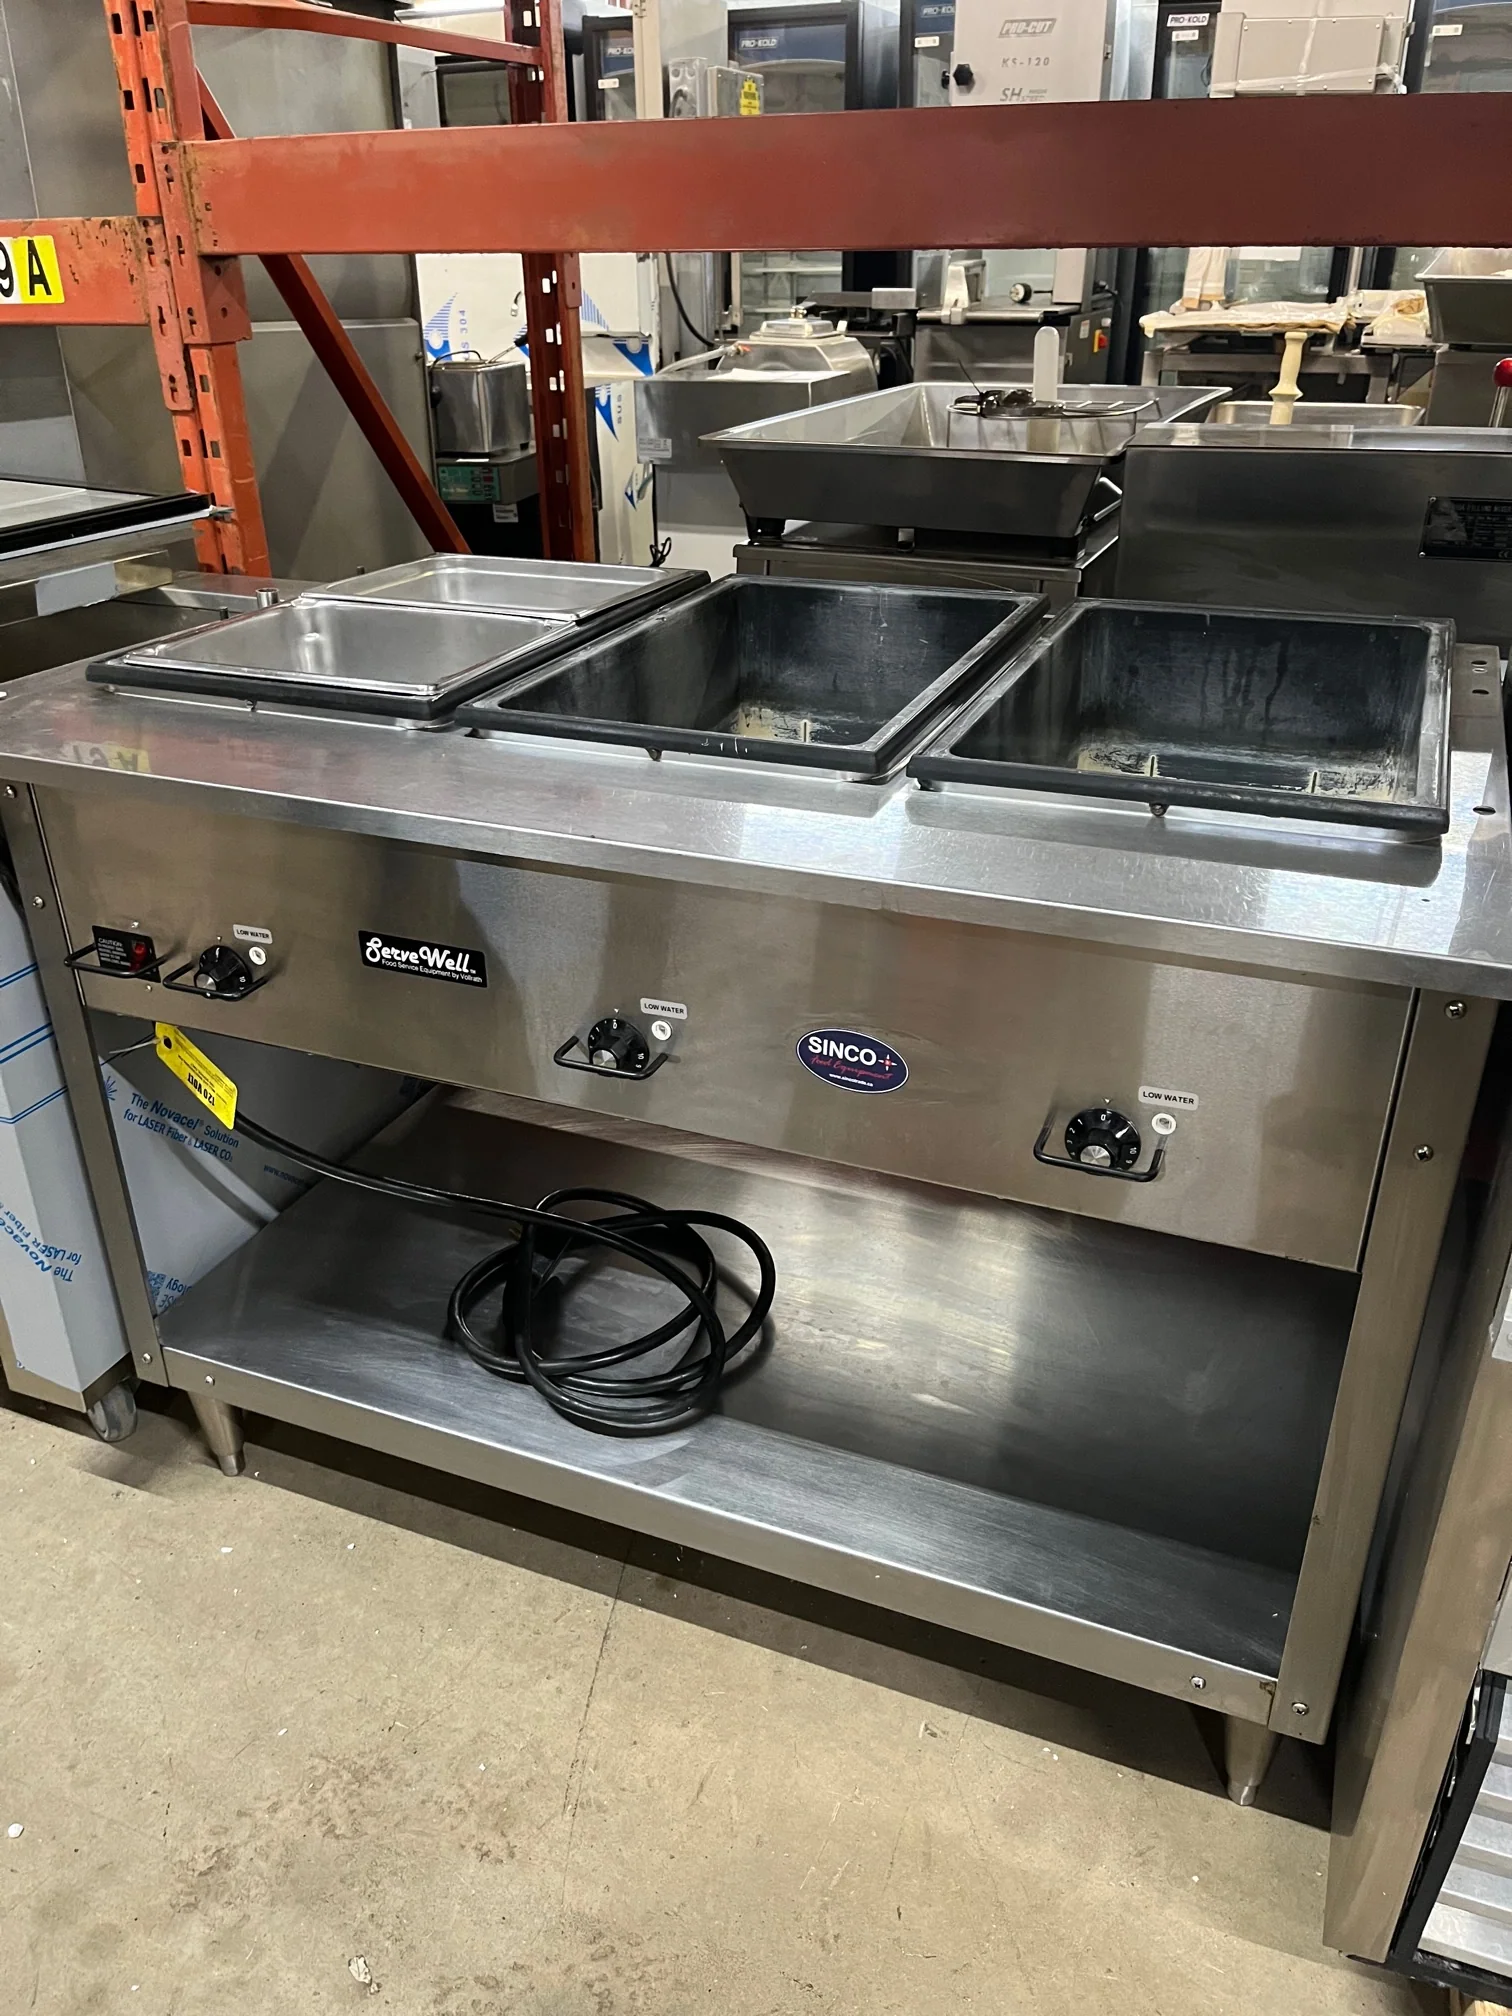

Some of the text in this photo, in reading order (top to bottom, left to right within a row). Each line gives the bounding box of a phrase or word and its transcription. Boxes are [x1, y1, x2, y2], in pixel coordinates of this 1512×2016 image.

[1002, 21, 1053, 34] PRO-CUT
[250, 931, 269, 939] WATER
[382, 959, 397, 968] Food
[398, 962, 419, 972] Service
[419, 966, 451, 977] Equipment
[451, 971, 460, 980] by
[660, 1005, 684, 1014] WATER
[808, 1036, 877, 1066] SINCO
[1142, 1091, 1195, 1104] LOW WATER
[131, 1093, 149, 1110] The
[203, 1125, 239, 1148] Solution
[123, 1108, 138, 1122] for
[138, 1115, 165, 1134] LASER
[166, 1126, 188, 1143] Fiber
[194, 1138, 220, 1157] LASER
[4, 1210, 82, 1266] for LASER Fiber
[54, 1266, 73, 1282] The
